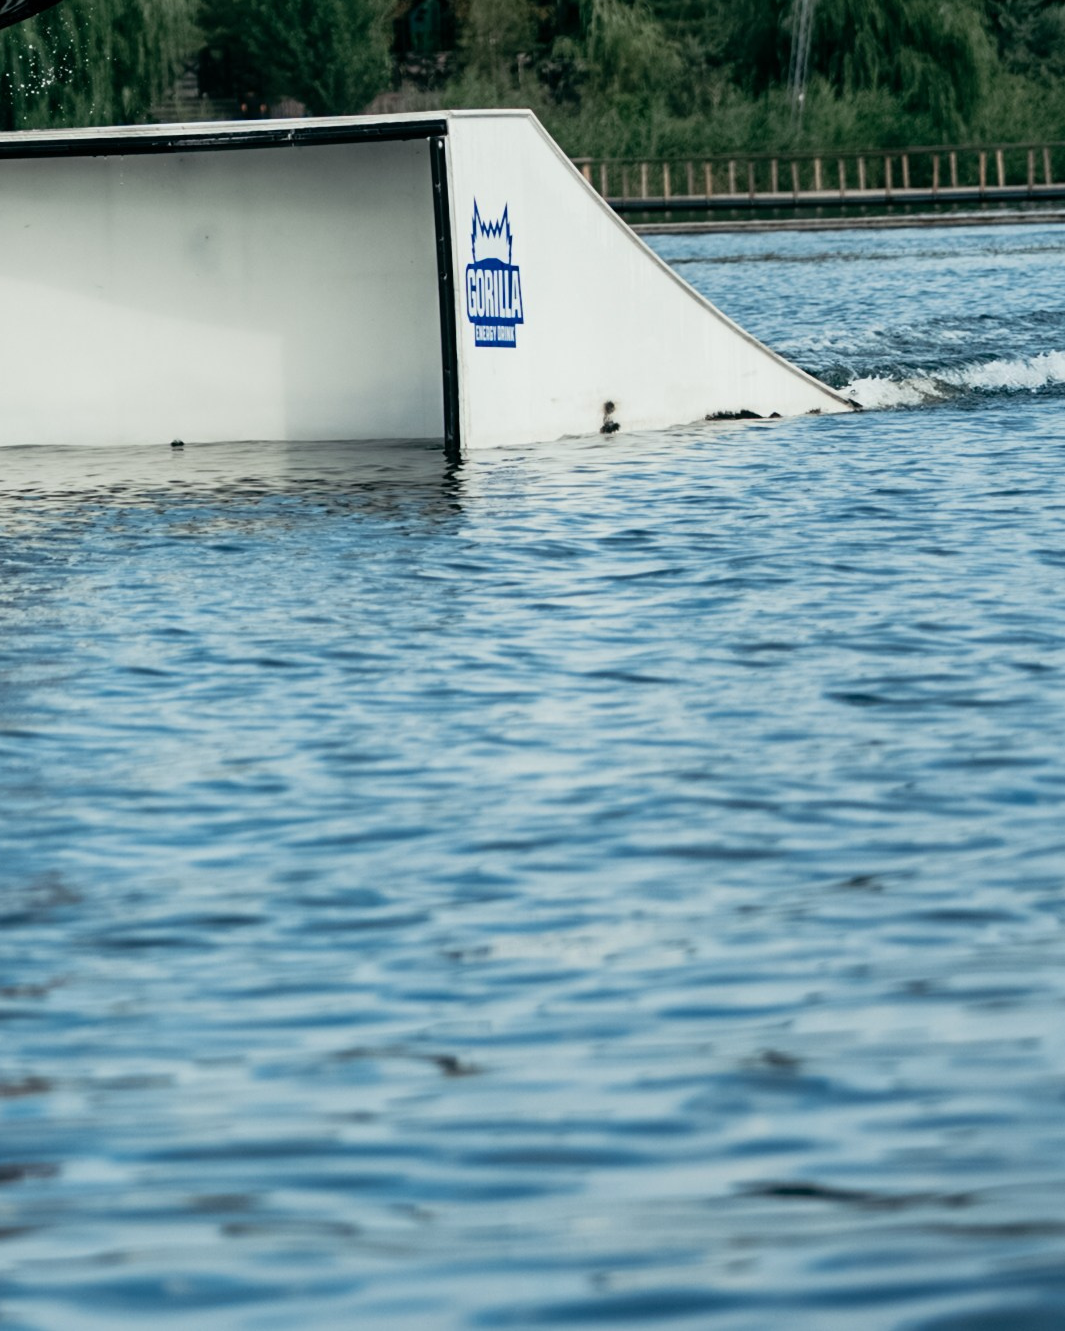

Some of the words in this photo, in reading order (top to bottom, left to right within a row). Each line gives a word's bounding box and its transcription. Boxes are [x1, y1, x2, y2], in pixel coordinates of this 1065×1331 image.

[467, 268, 522, 318] GORILLA
[476, 325, 496, 341] ENERGY
[497, 326, 515, 342] DRINK
